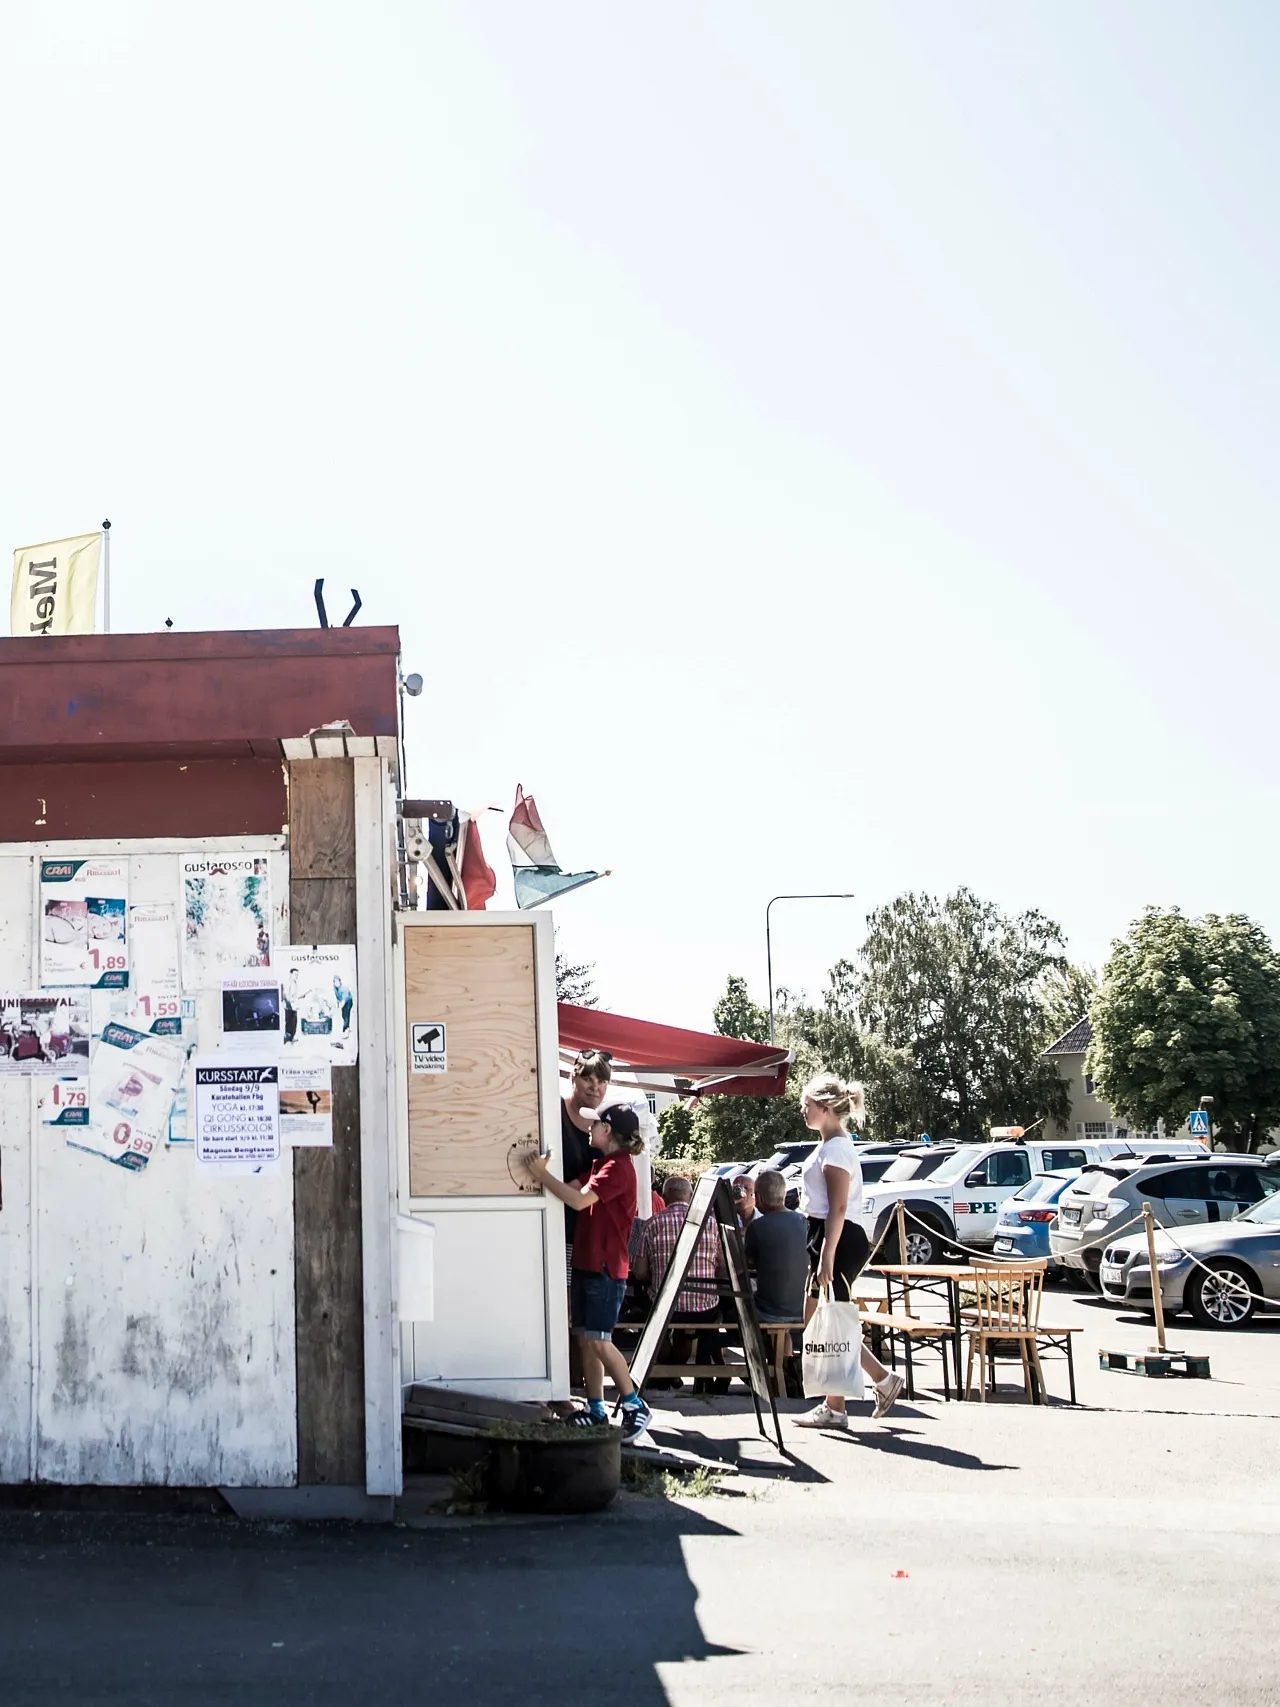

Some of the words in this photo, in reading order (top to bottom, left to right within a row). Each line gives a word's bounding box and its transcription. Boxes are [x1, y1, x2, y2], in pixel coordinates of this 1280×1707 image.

[88, 948, 126, 971] 1,89
[139, 995, 178, 1018] 1,59
[198, 1069, 260, 1083] KURSSTART
[52, 1083, 87, 1107] 1,79
[220, 1084, 243, 1093] Söndag
[245, 1083, 260, 1094] 9/9
[211, 1102, 239, 1112] YOGA
[216, 1113, 247, 1122] GONG
[203, 1122, 274, 1133] CIRKUSSKOLOR
[112, 1122, 153, 1155] 0,99
